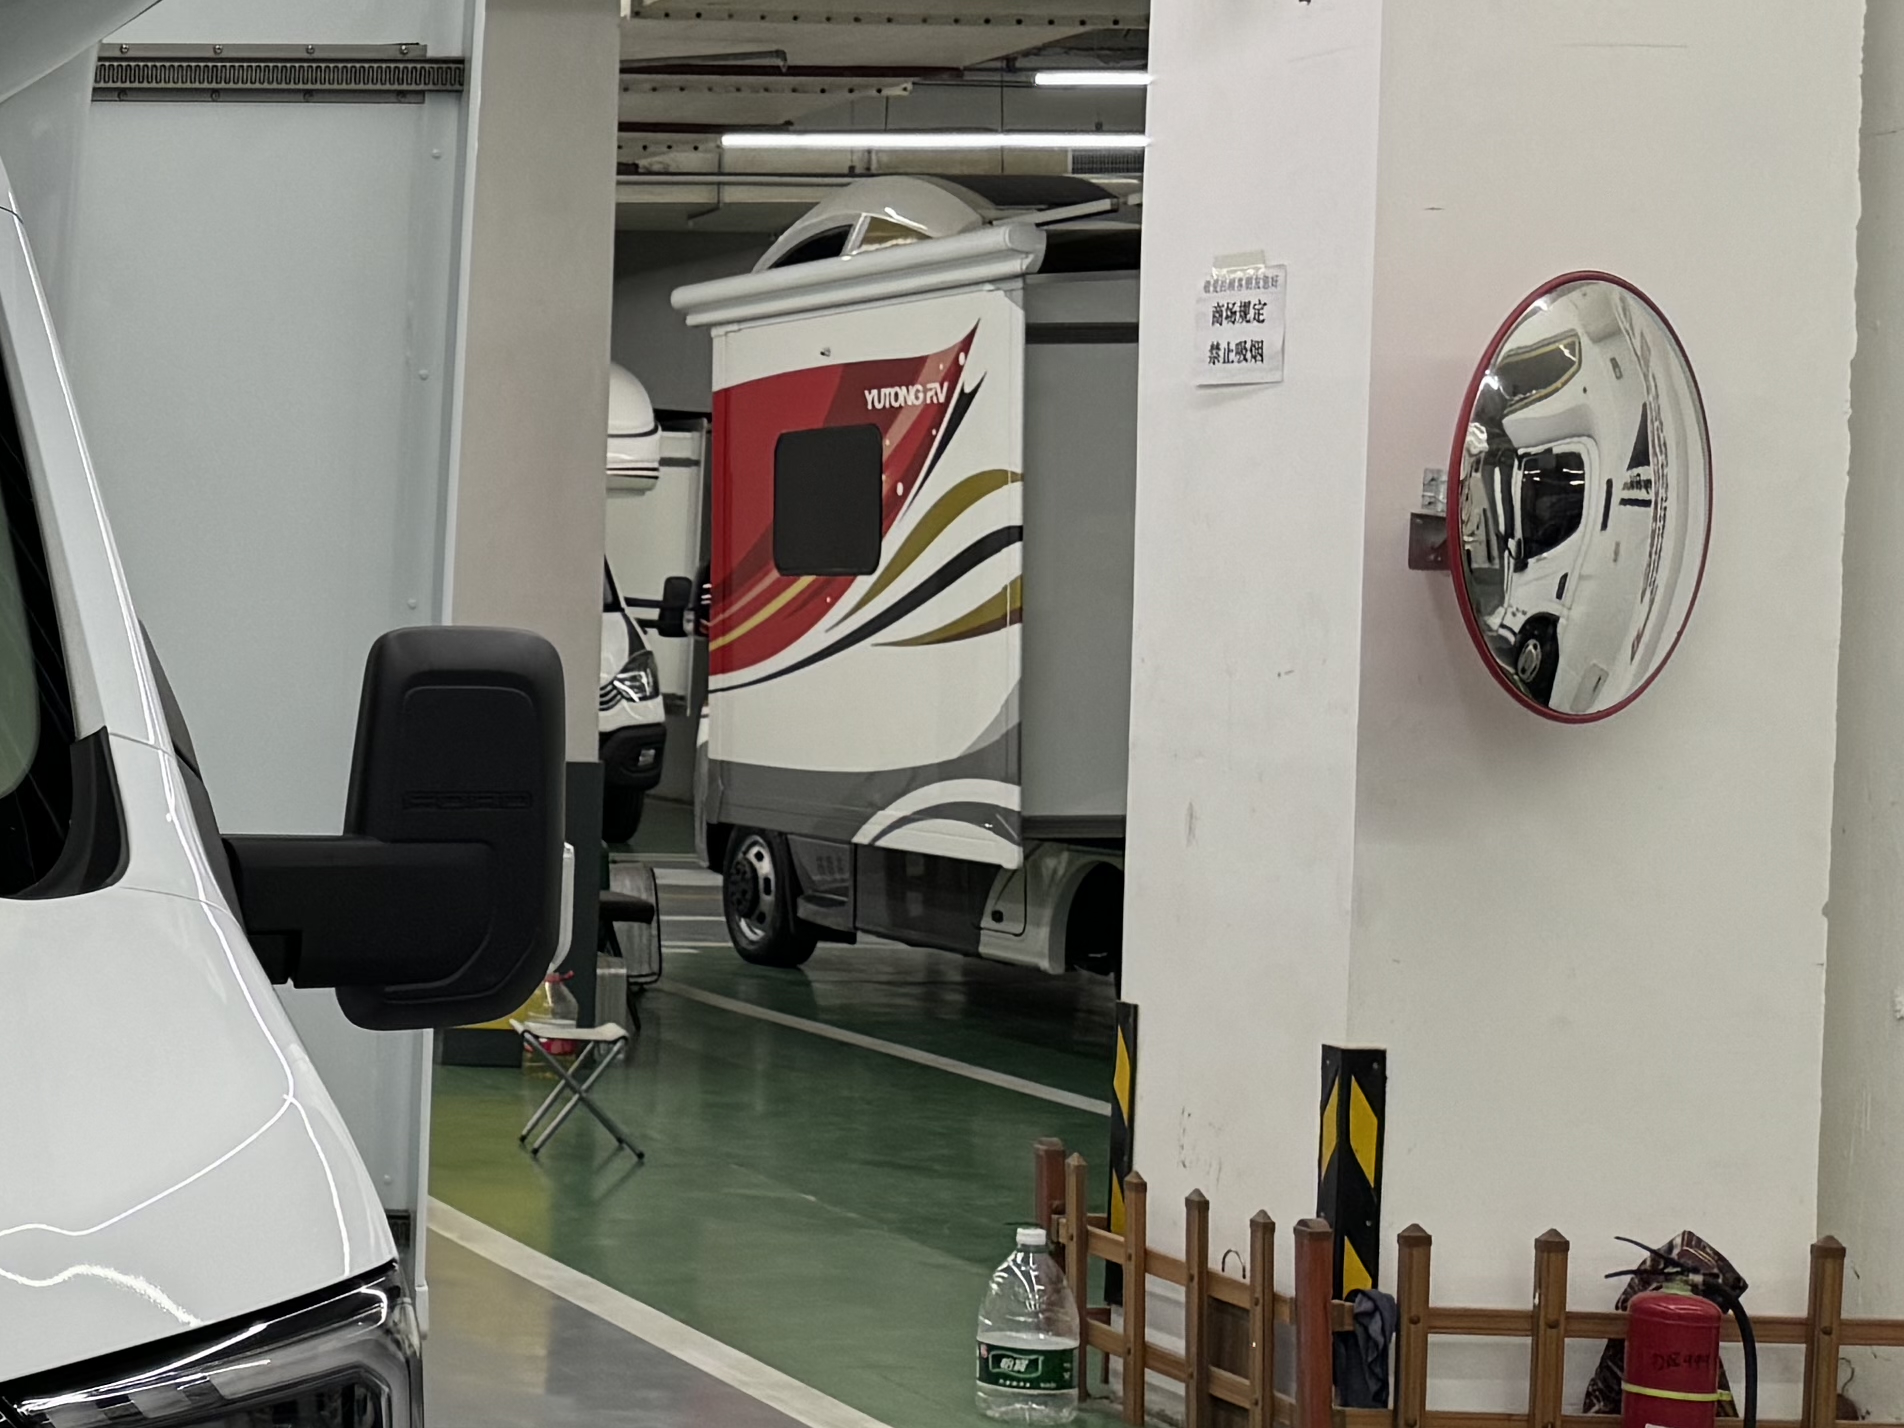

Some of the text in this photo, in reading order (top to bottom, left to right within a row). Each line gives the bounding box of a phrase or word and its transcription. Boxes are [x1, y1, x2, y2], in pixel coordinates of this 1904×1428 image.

[1211, 299, 1267, 326] 商场规定
[1208, 339, 1264, 365] 禁止吸烟
[864, 381, 949, 410] YUTONG RV
